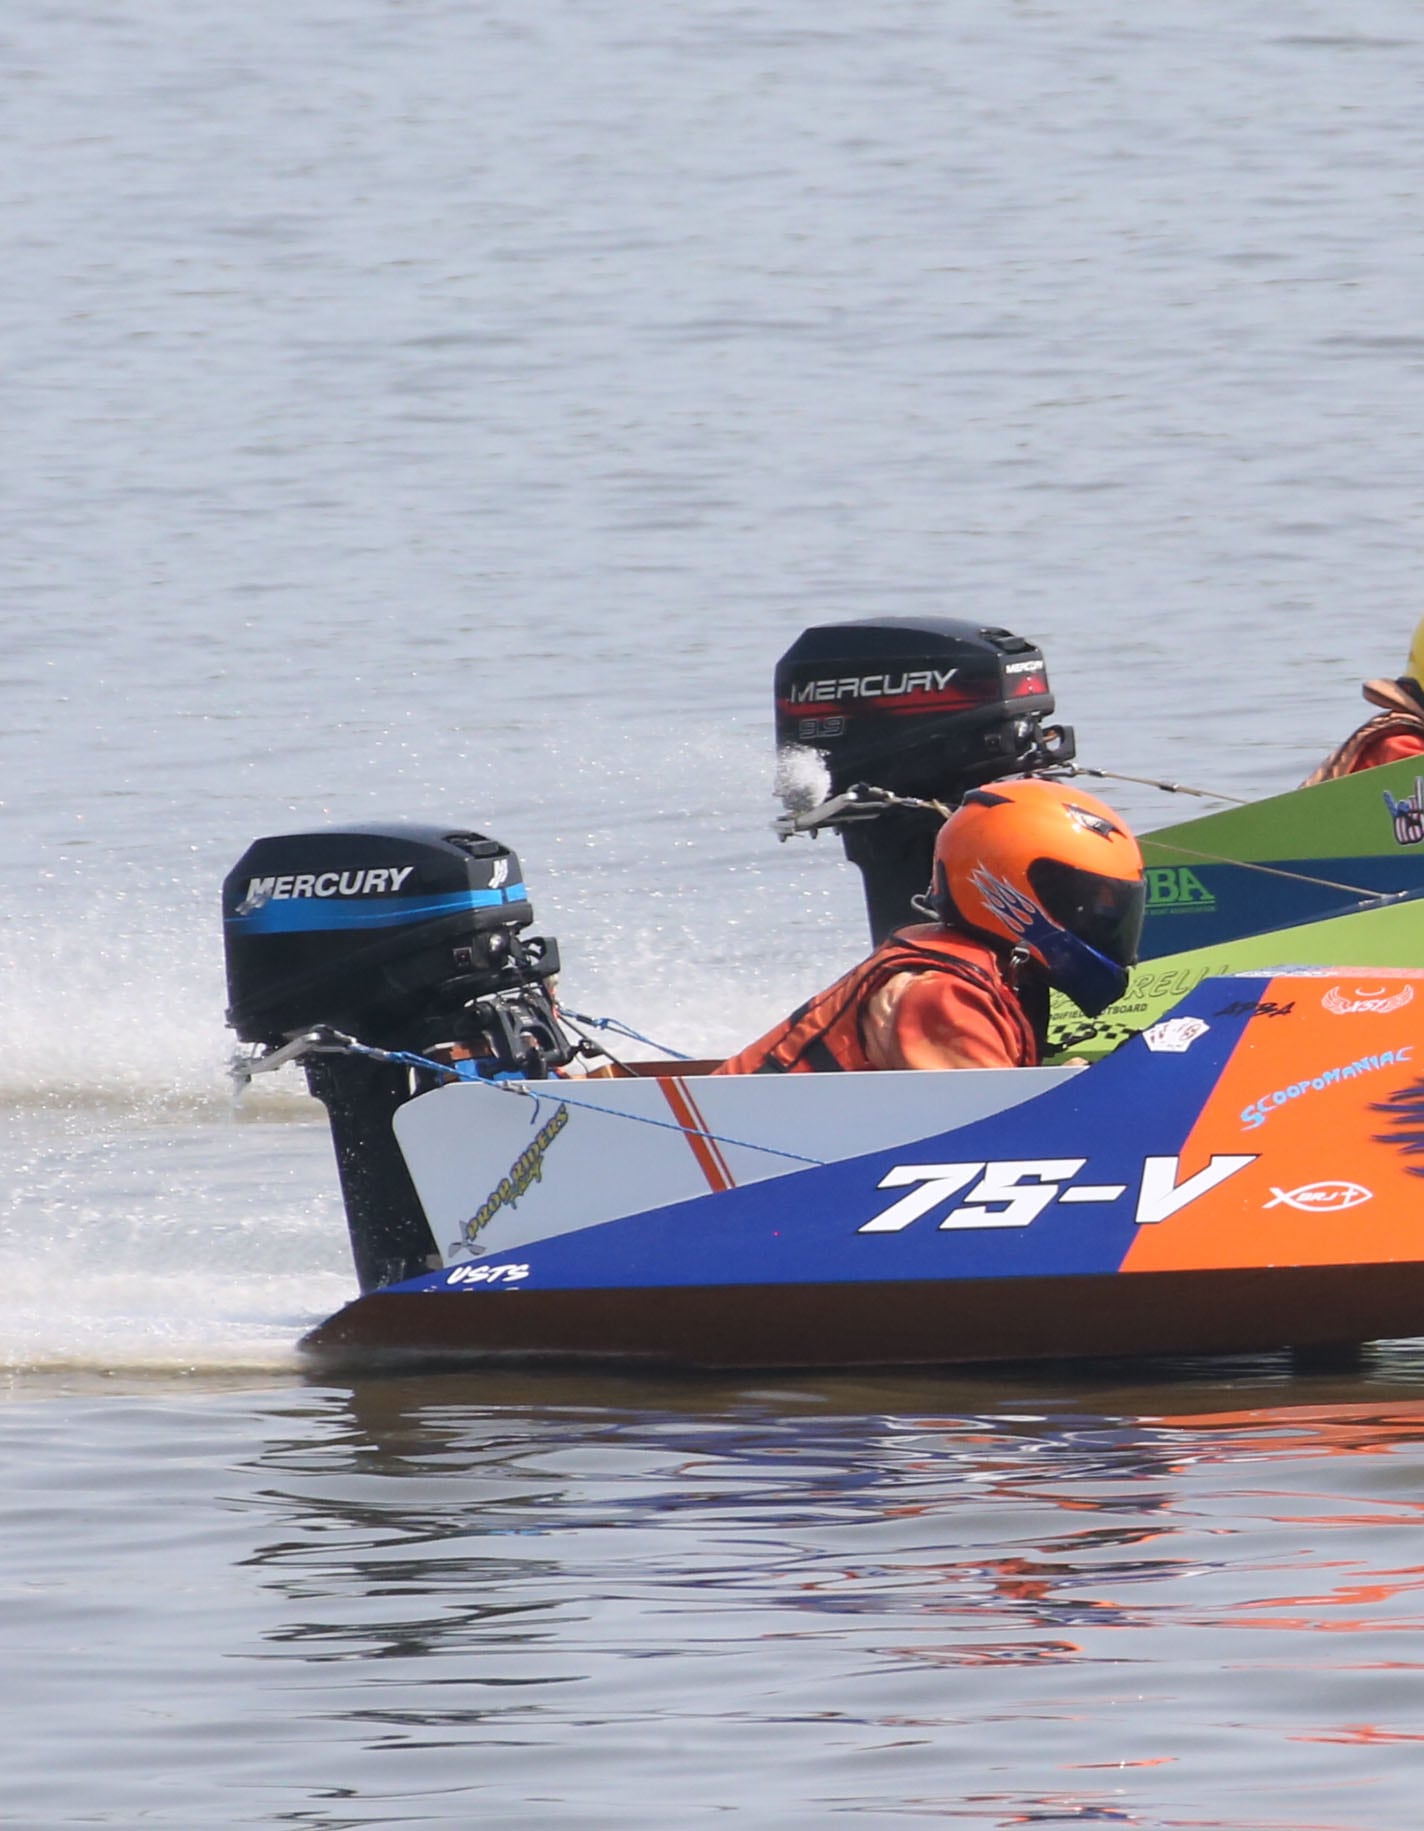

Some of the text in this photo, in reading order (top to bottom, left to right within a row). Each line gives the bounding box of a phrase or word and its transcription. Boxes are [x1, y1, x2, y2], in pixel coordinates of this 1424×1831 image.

[786, 668, 958, 703] MERCURY
[246, 866, 414, 900] MERCURY
[1146, 867, 1216, 903] BA
[1239, 1045, 1414, 1131] SCOOPOMANIAC
[465, 1177, 512, 1242] PROP
[857, 1154, 1263, 1234] 75-V
